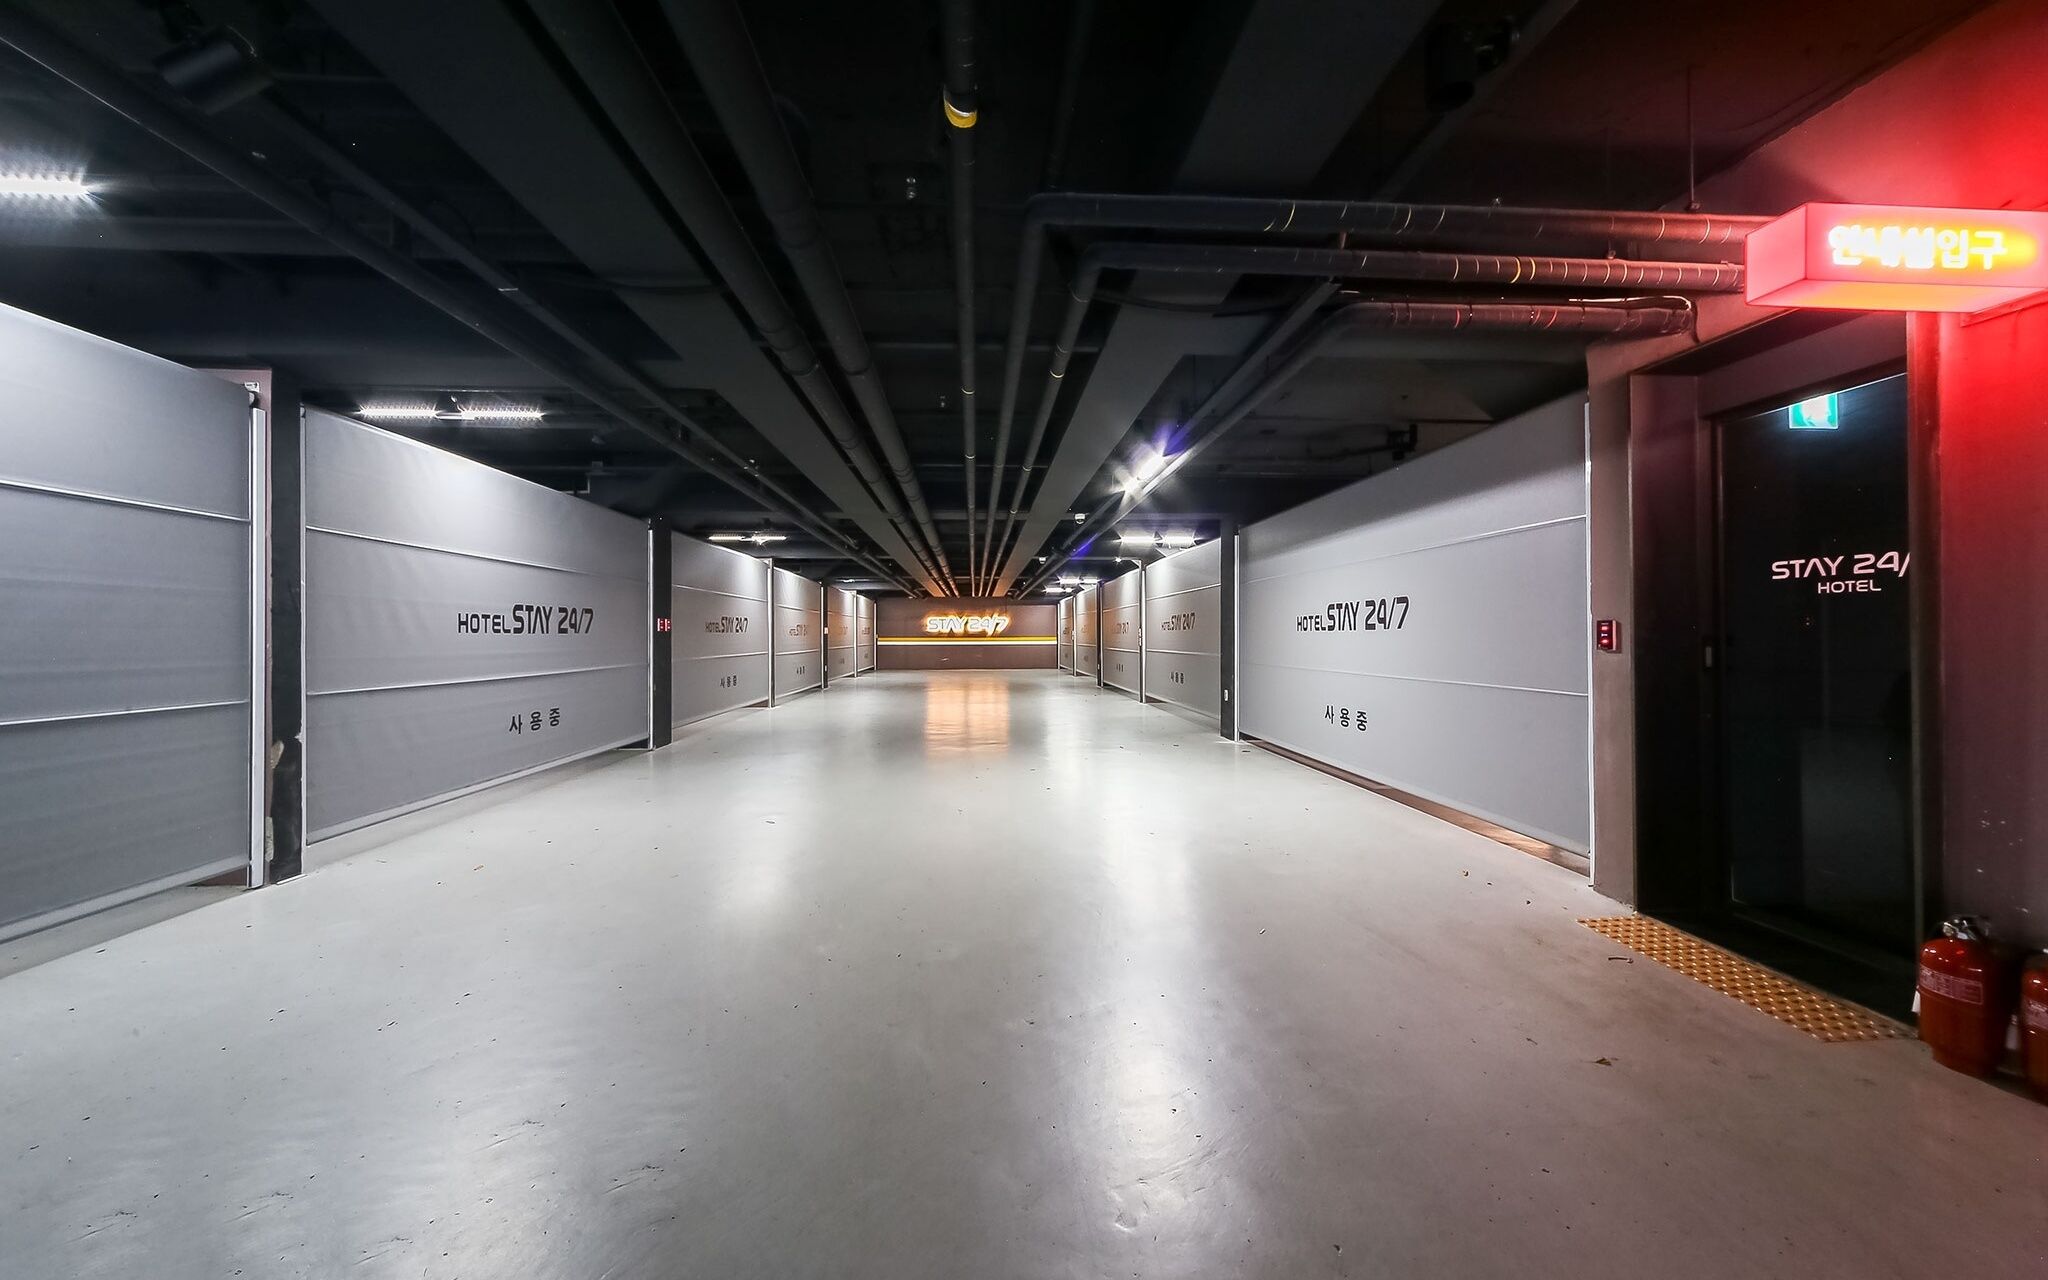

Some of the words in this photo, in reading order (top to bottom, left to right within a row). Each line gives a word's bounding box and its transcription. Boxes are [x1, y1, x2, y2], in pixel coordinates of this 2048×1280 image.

[1771, 556, 1844, 580] STAY
[1853, 550, 1911, 578] 24/
[1817, 579, 1882, 594] HOTEL
[457, 612, 511, 634] HOTEL
[512, 604, 553, 635] STAY
[558, 607, 594, 635] 24/7
[927, 616, 966, 632] STAY
[969, 614, 1008, 635] 24/7
[1296, 614, 1326, 632] HOTEL
[1327, 601, 1360, 631] STAY
[1365, 596, 1410, 631] 24/7
